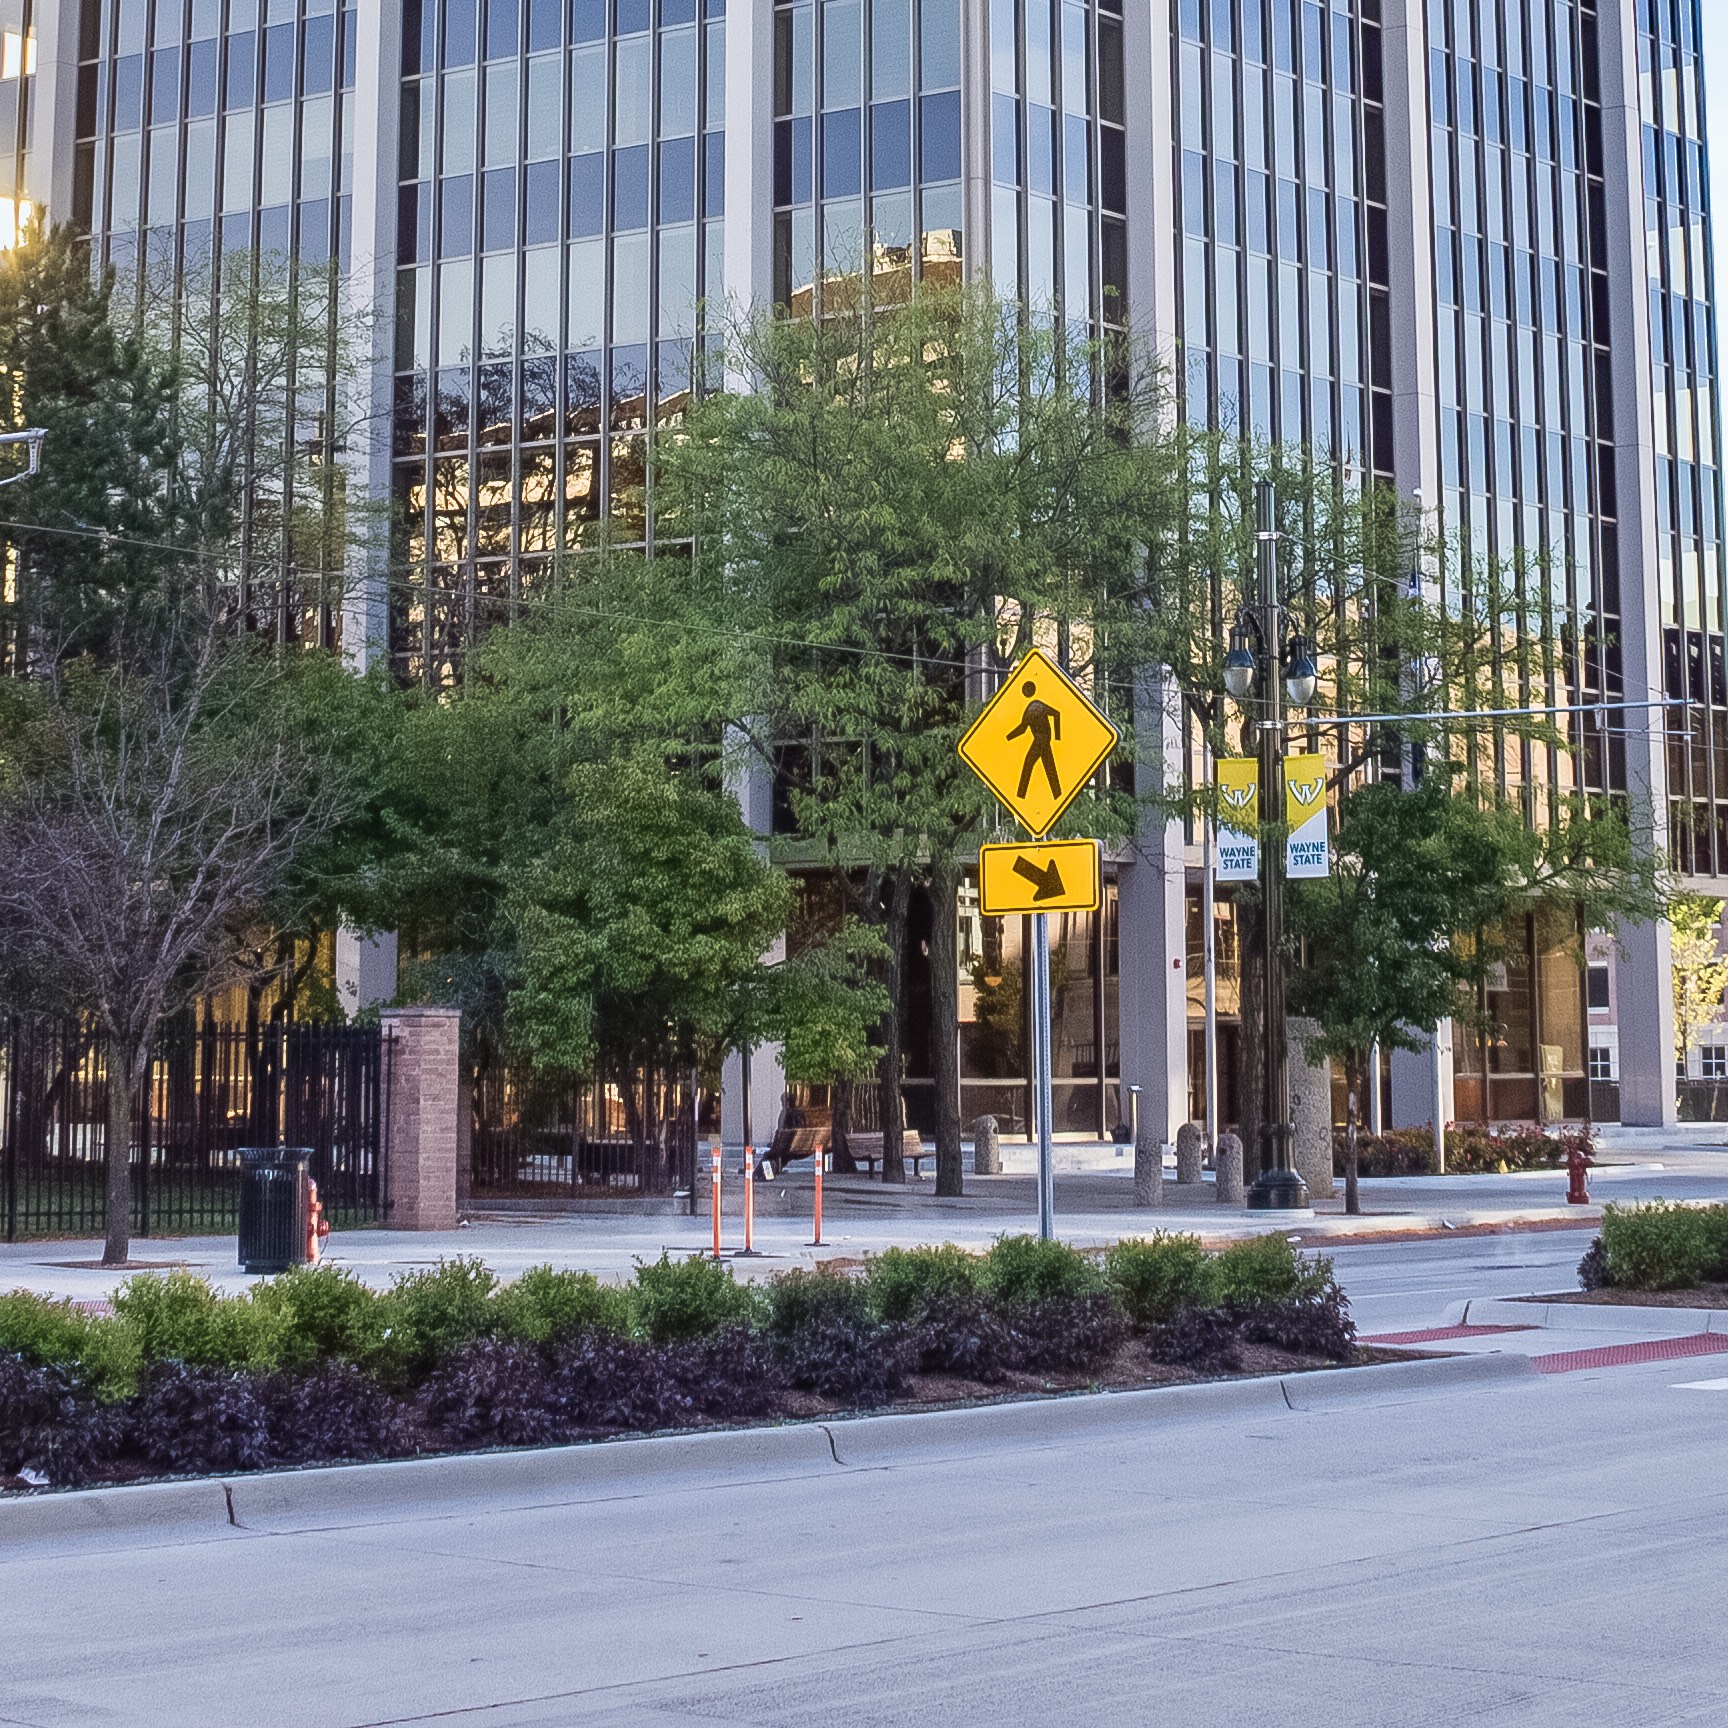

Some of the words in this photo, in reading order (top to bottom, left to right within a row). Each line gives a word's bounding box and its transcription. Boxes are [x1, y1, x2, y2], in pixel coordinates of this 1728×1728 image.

[1220, 783, 1256, 809] W
[1287, 777, 1324, 806] W
[1219, 846, 1255, 858] WAYNE
[1289, 841, 1325, 854] WAYNE
[1223, 858, 1252, 870] STATE
[1293, 854, 1323, 866] STATE
